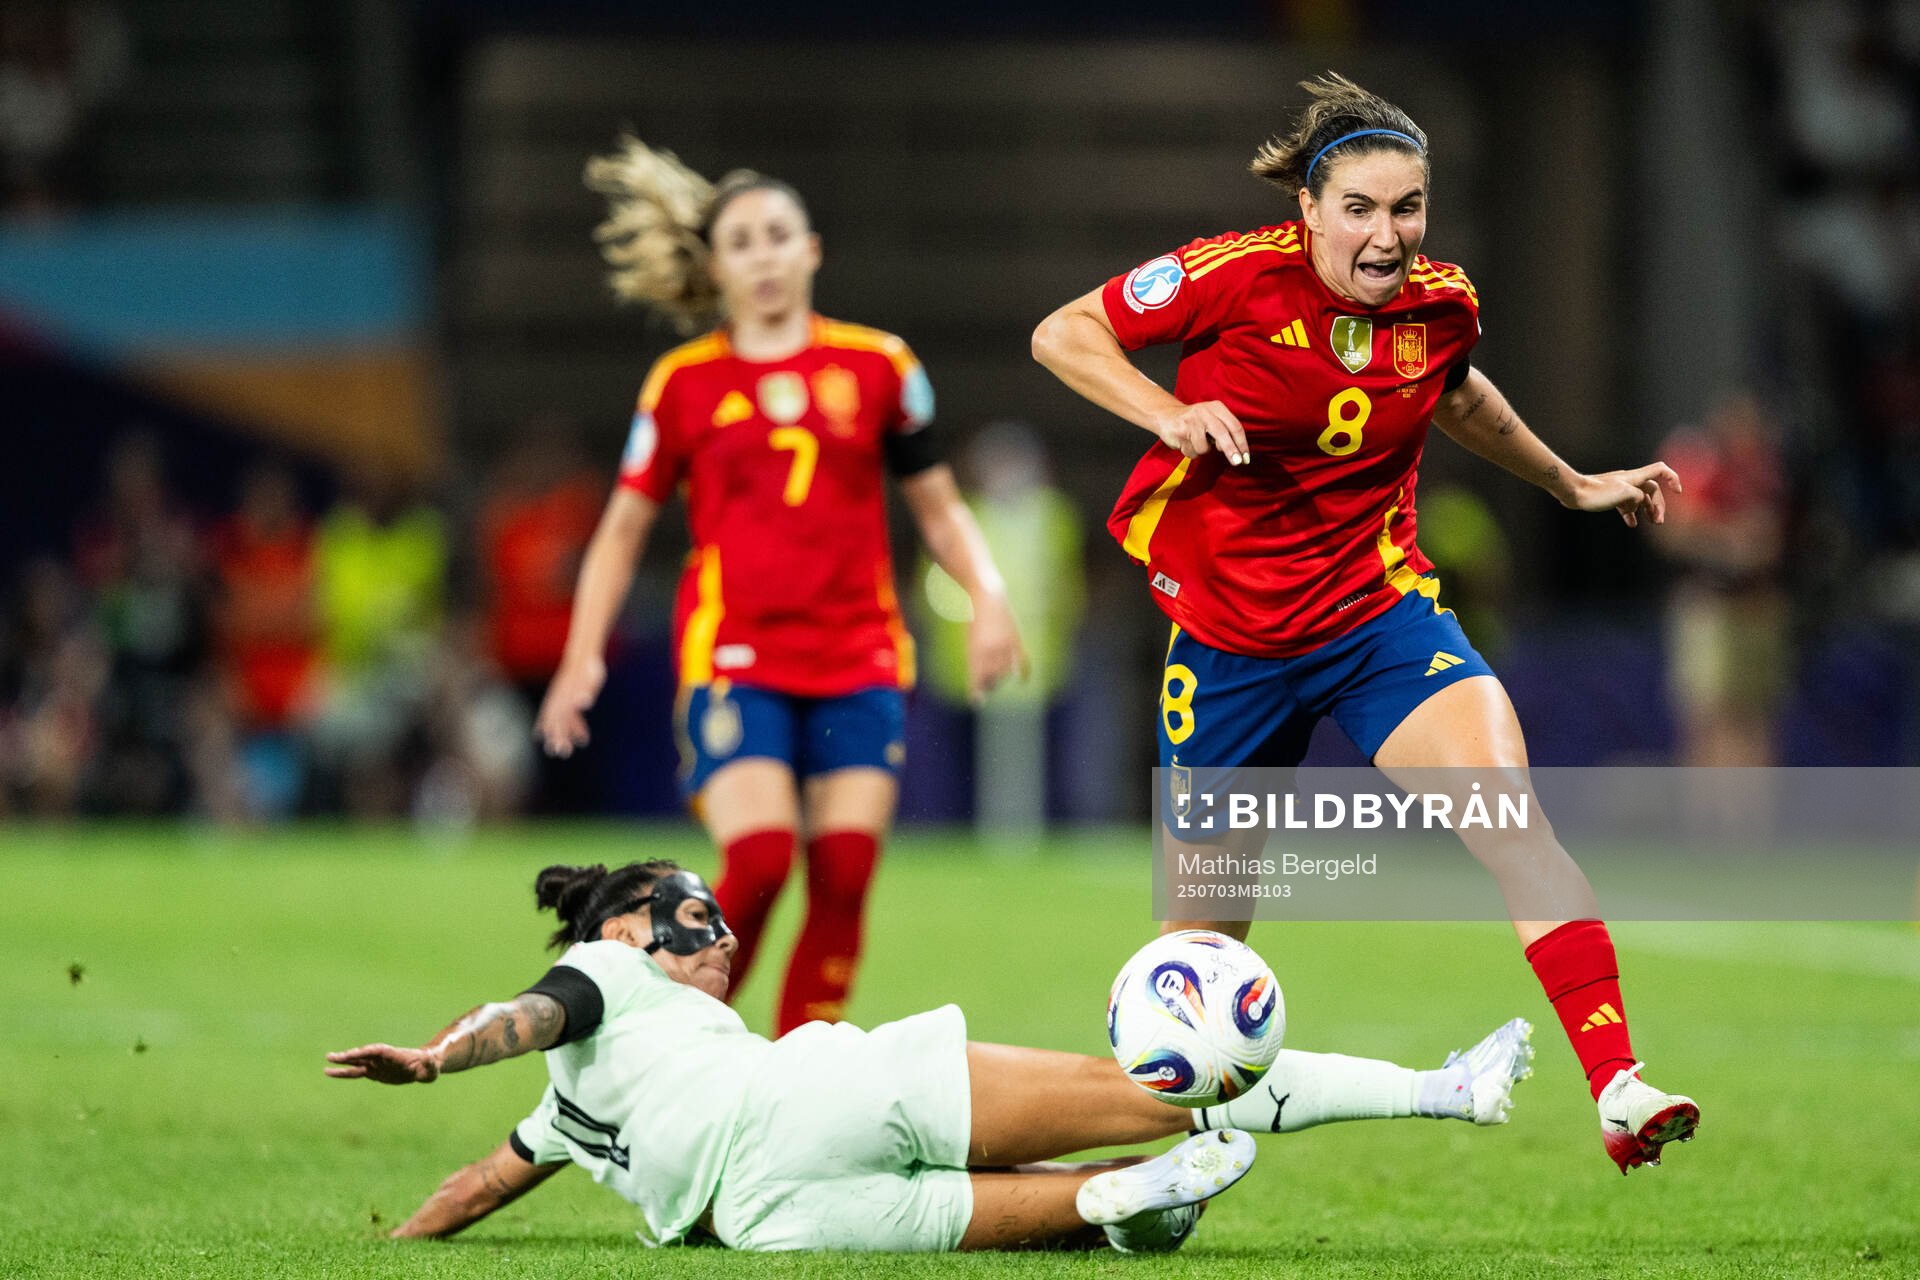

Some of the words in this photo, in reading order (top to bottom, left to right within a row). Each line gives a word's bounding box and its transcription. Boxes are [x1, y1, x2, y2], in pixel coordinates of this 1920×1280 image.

[1317, 387, 1371, 456] 8
[768, 425, 819, 506] 7
[1163, 664, 1197, 745] 8
